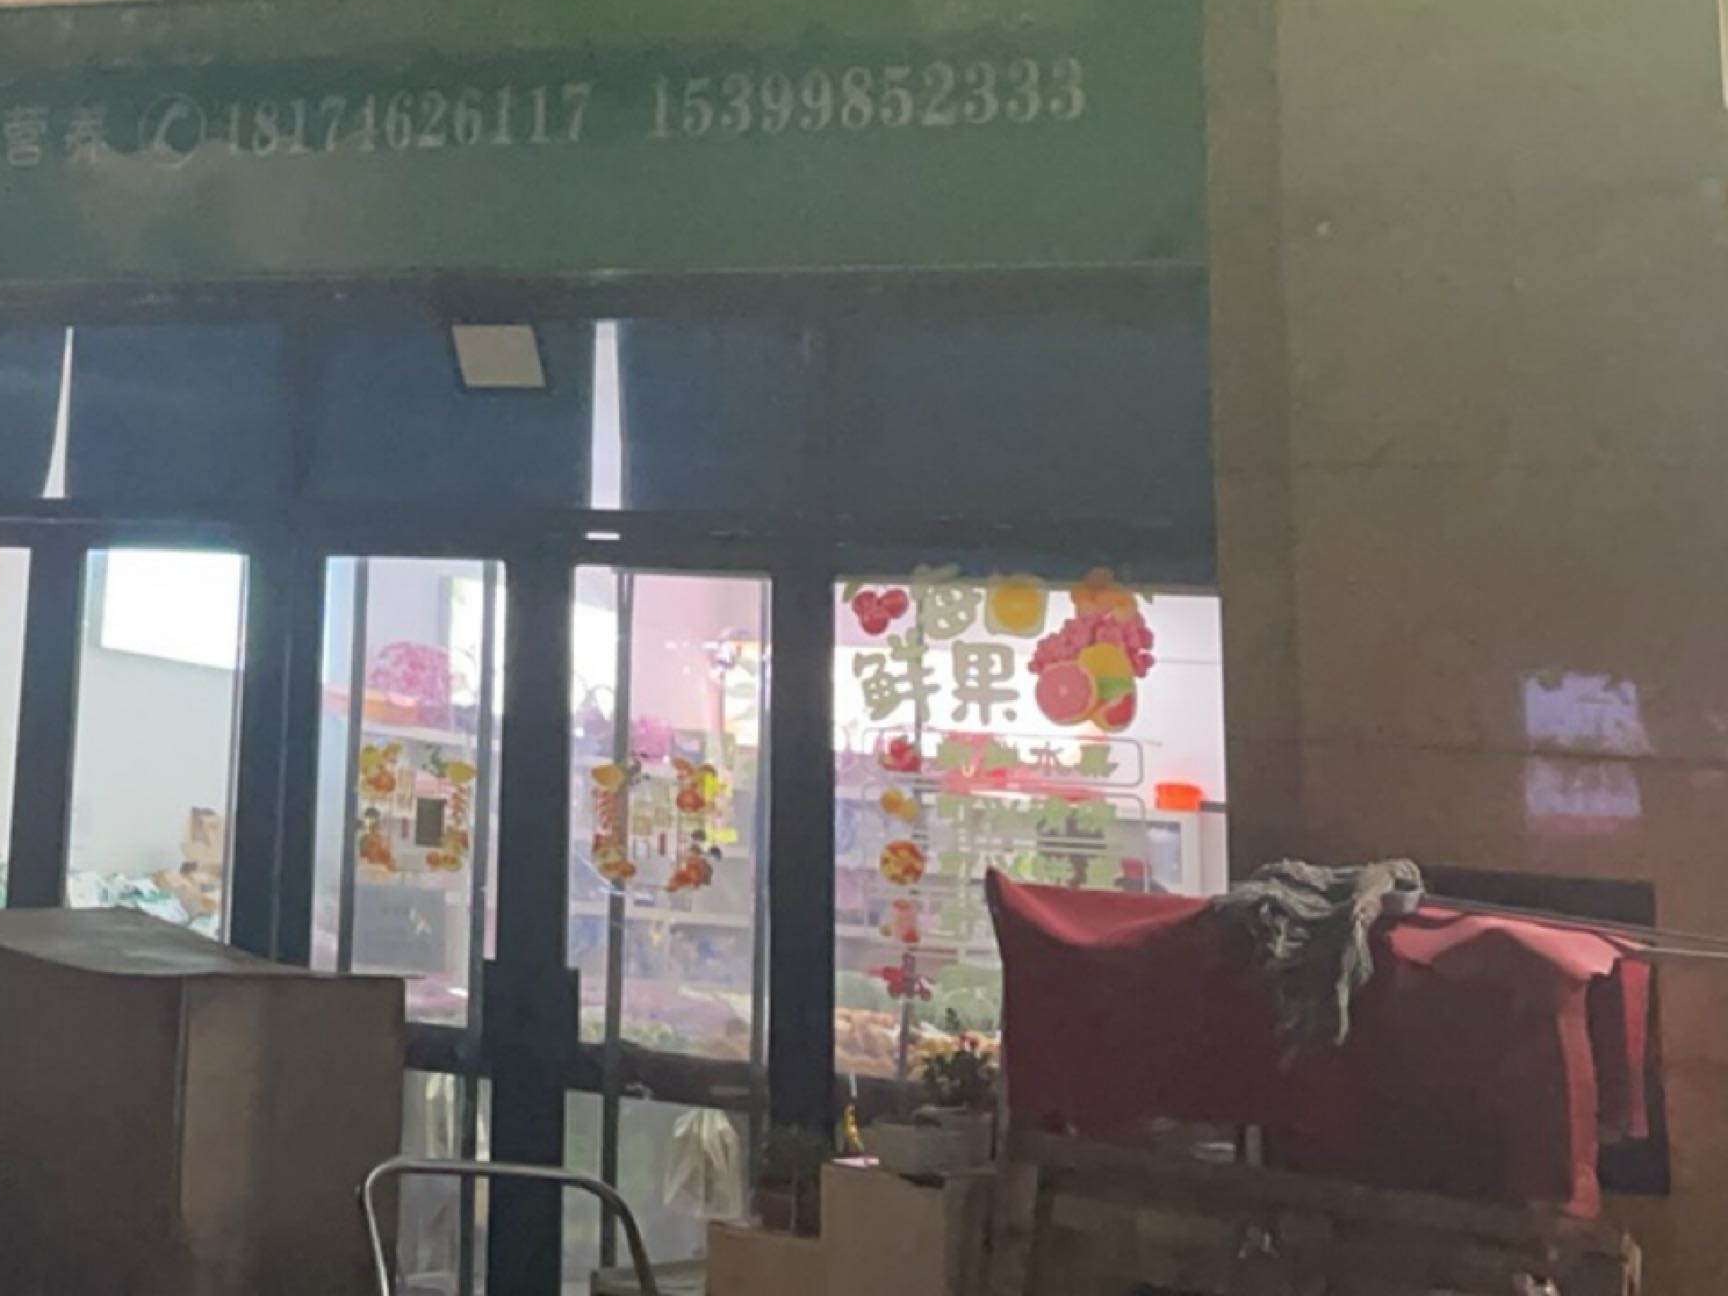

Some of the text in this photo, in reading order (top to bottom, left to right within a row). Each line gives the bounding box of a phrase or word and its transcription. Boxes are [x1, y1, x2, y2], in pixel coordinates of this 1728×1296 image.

[227, 80, 594, 158] 18174626117
[645, 55, 1088, 140] 15399852333
[852, 627, 1019, 726] 鲜果
